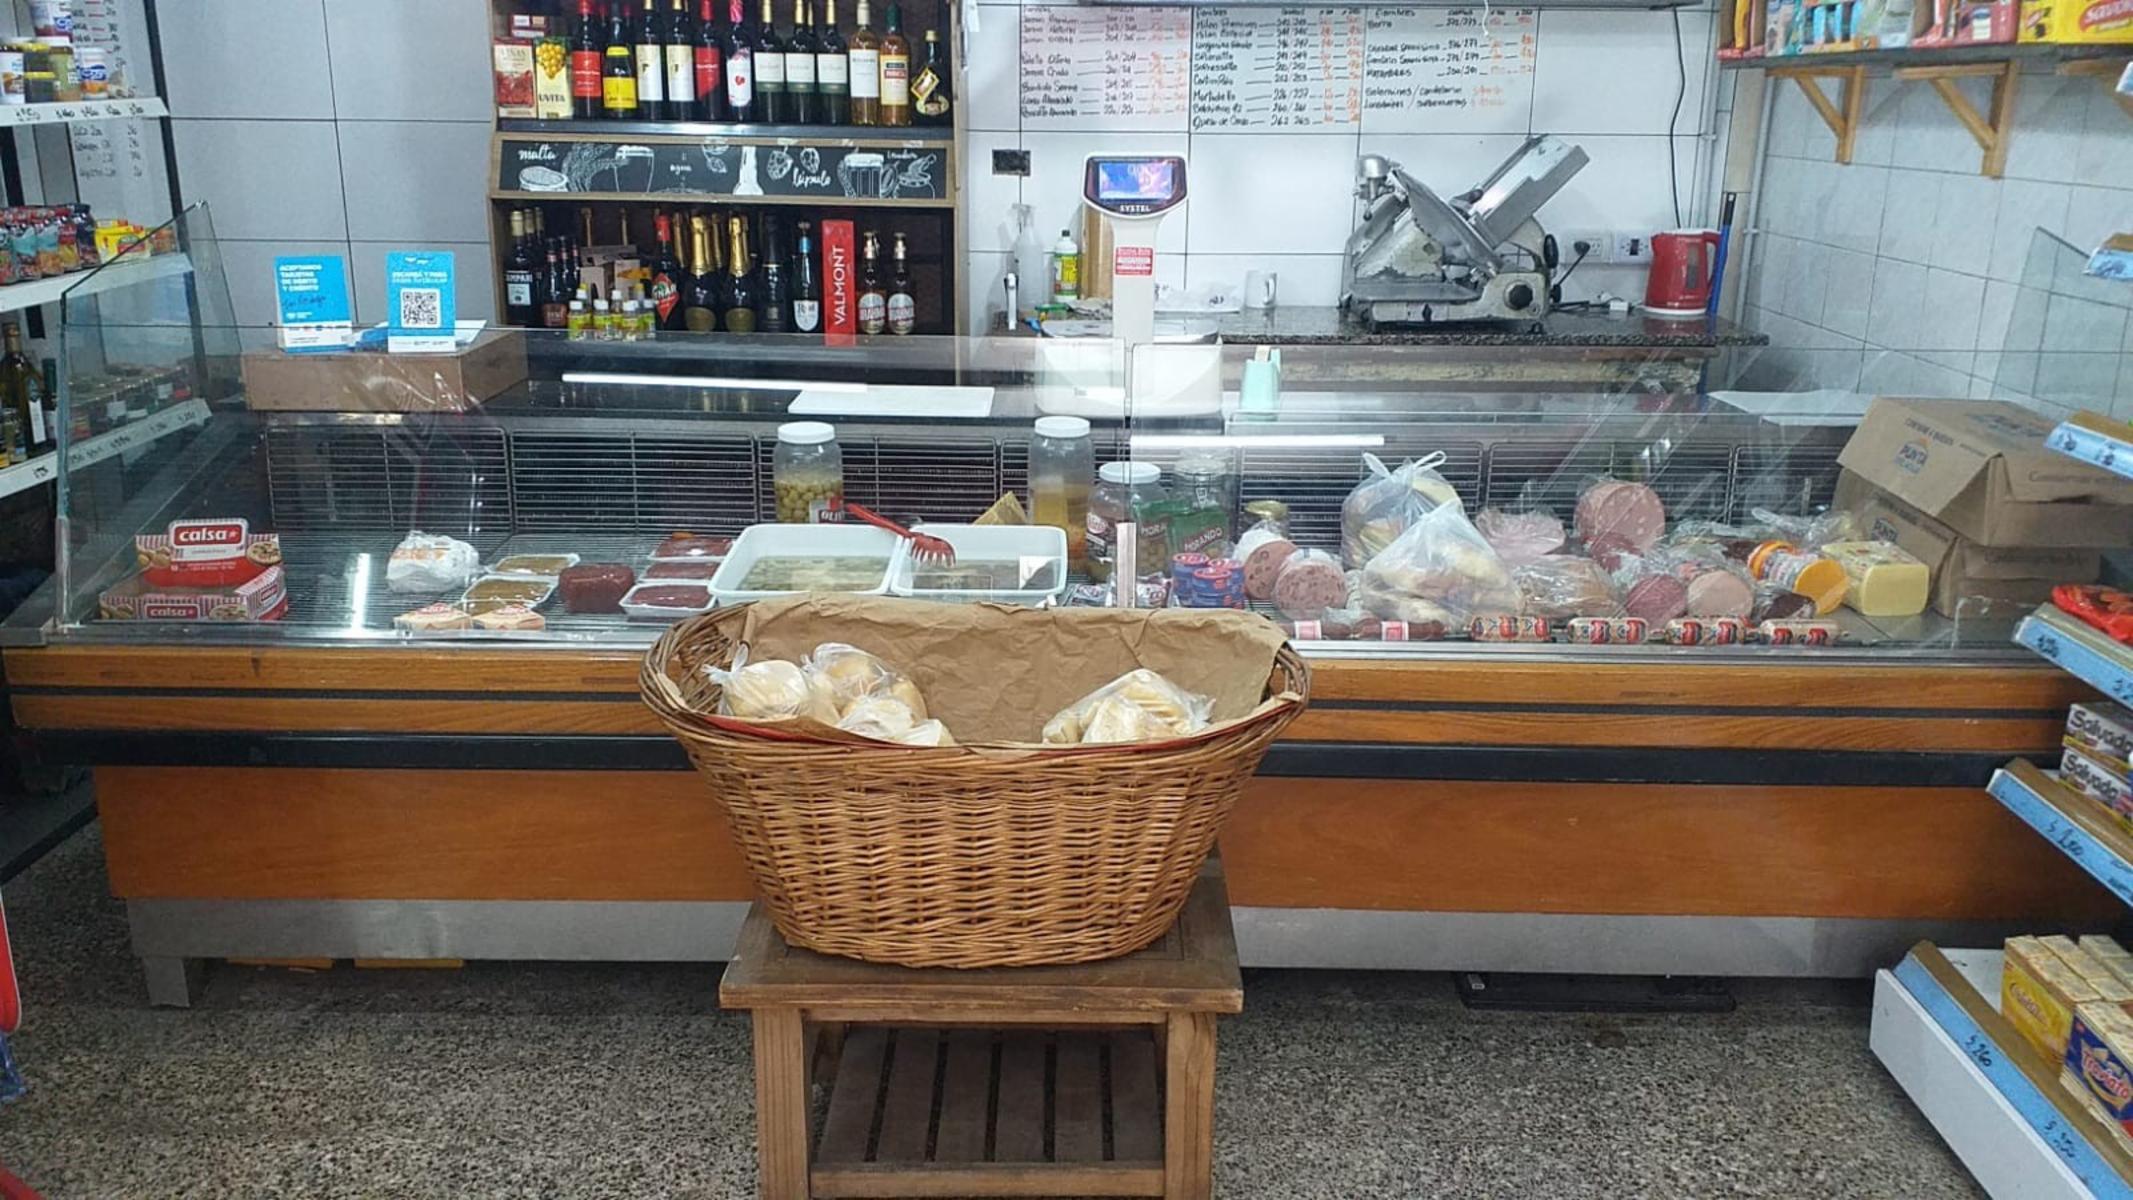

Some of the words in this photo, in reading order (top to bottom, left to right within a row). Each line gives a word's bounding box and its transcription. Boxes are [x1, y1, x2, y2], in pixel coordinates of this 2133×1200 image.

[518, 145, 557, 160] malta
[670, 164, 692, 175] agua
[832, 245, 846, 326] VALMONT
[178, 528, 228, 542] calsa
[1184, 527, 1223, 551] MORANDO
[150, 607, 188, 618] calsa
[2069, 709, 2133, 755] Salvado
[2063, 754, 2118, 801] Salvado
